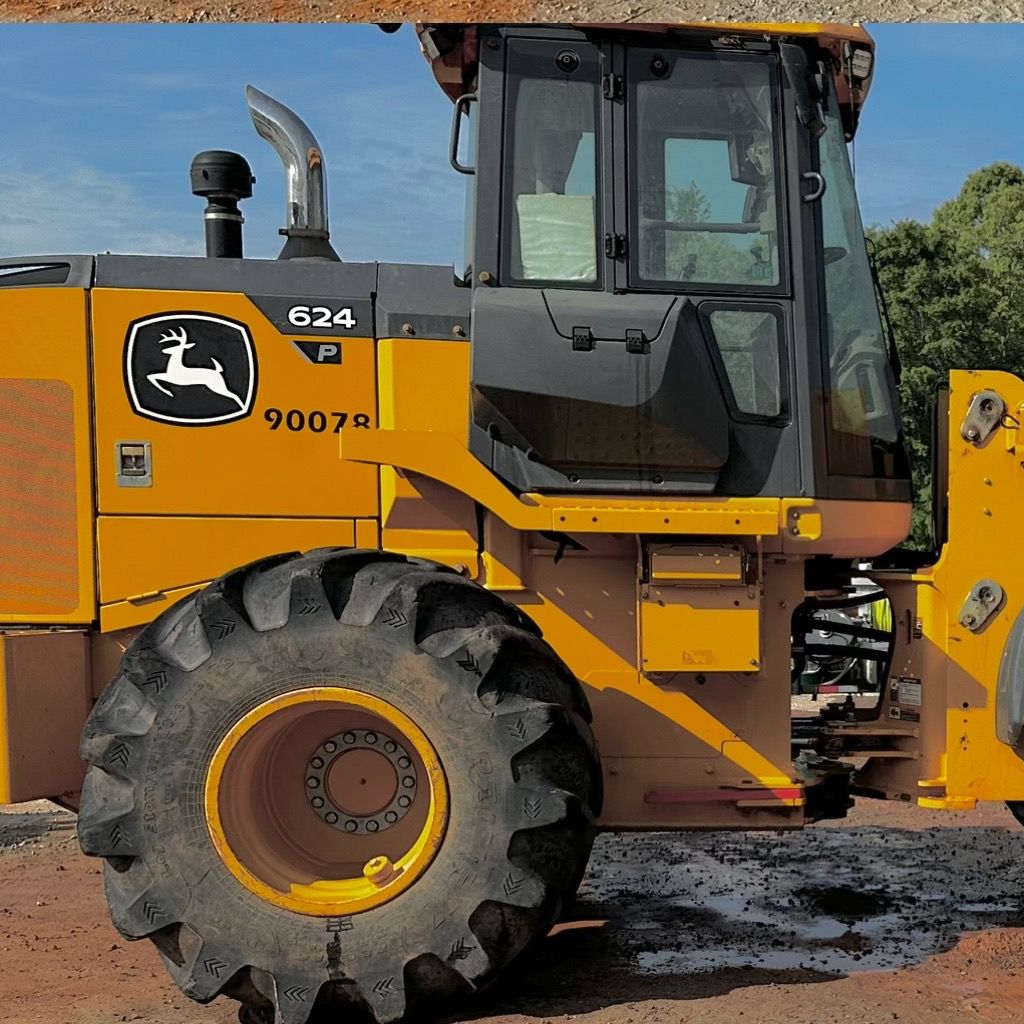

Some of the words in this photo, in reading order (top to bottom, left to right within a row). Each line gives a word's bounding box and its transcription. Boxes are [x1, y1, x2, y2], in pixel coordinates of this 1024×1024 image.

[287, 305, 357, 329] 624
[317, 343, 338, 362] P
[263, 407, 371, 434] 90078
